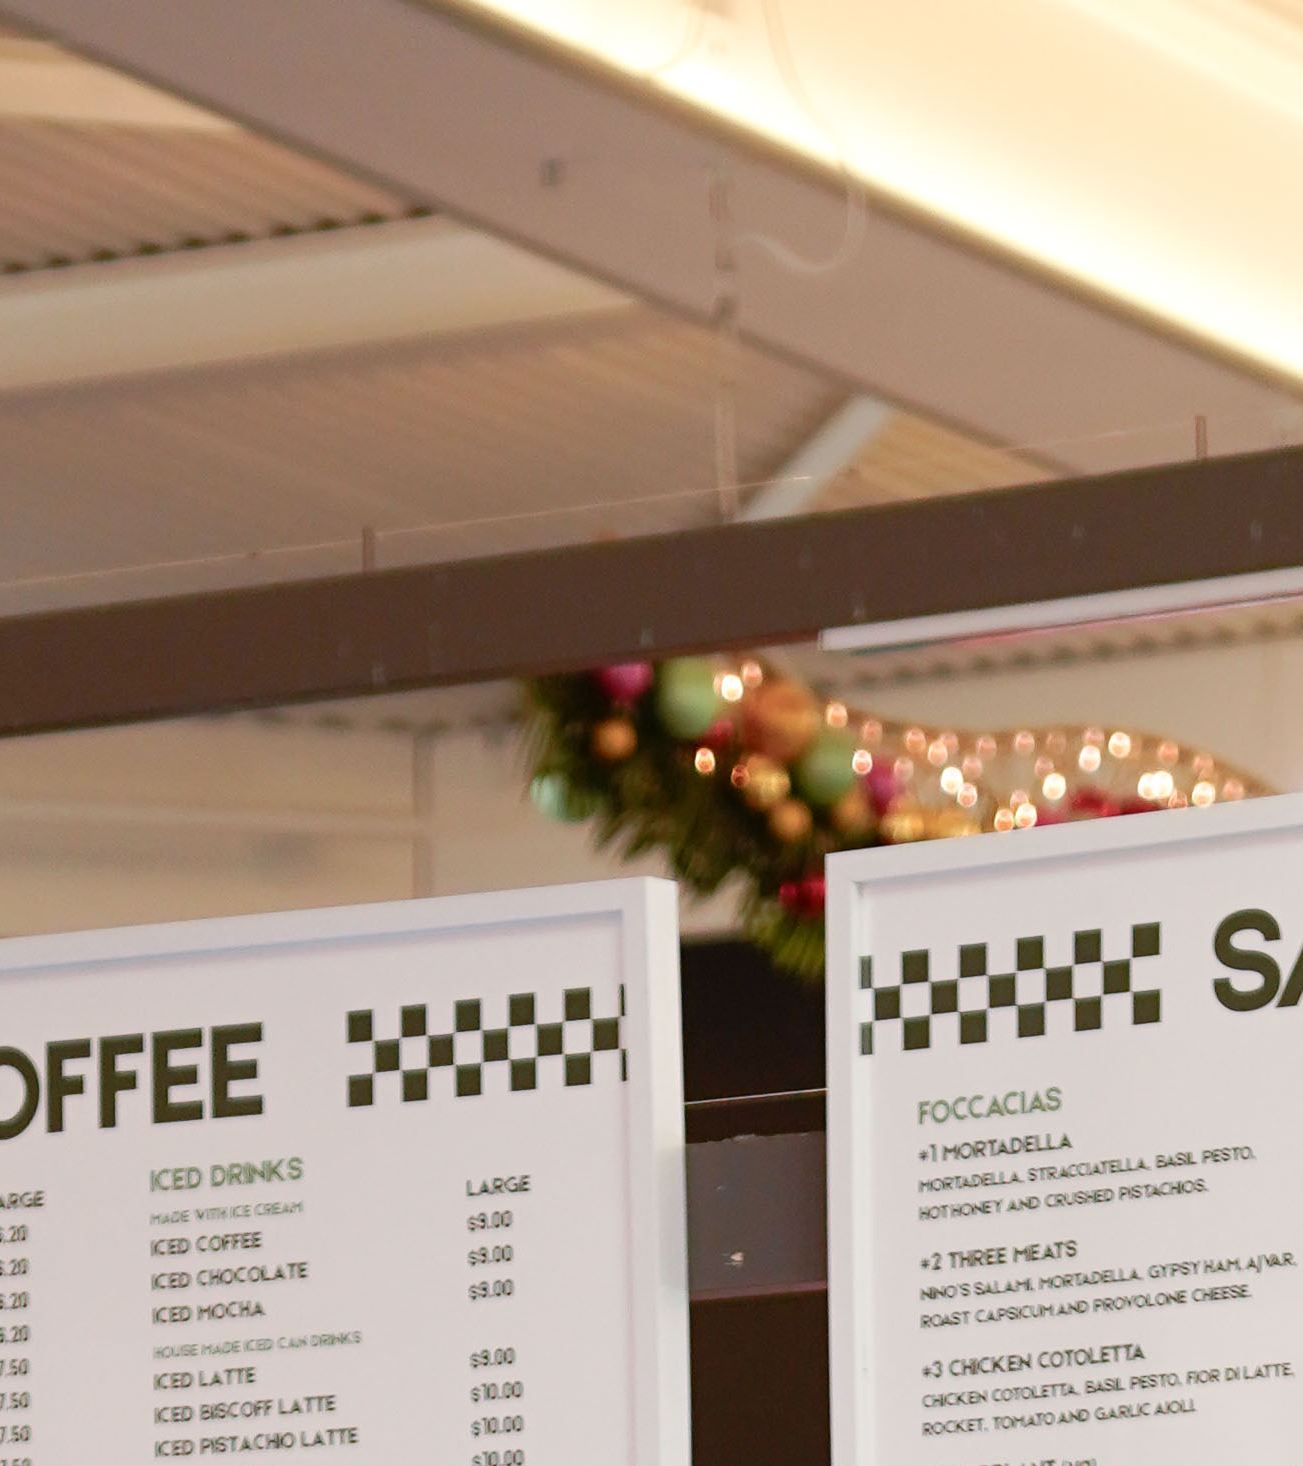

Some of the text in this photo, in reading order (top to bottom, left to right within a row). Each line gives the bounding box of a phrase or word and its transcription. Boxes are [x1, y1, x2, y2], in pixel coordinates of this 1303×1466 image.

[917, 1086, 1062, 1125] FOCCACIAS
[941, 1133, 1073, 1161] MORTADELLA
[149, 1156, 303, 1192] ICED DRINKS
[465, 1173, 531, 1198] LARGE
[918, 1202, 949, 1221] HOT
[949, 1198, 1003, 1217] HONEY
[1005, 1194, 1041, 1212] AND
[1043, 1186, 1115, 1208] CRUSHED
[151, 1230, 262, 1256] ICED COFFEE
[946, 1245, 1007, 1269] THREE
[1011, 1238, 1078, 1263] MEATS
[150, 1260, 308, 1290] ICED CHOCOLATE
[947, 1352, 1033, 1377] CHICKEN
[1036, 1342, 1146, 1369] COTOLETTA
[153, 1365, 256, 1391] ICED LATTE
[469, 1379, 522, 1403] $10.00
[153, 1393, 337, 1424] ICED BISCOFF LATTE
